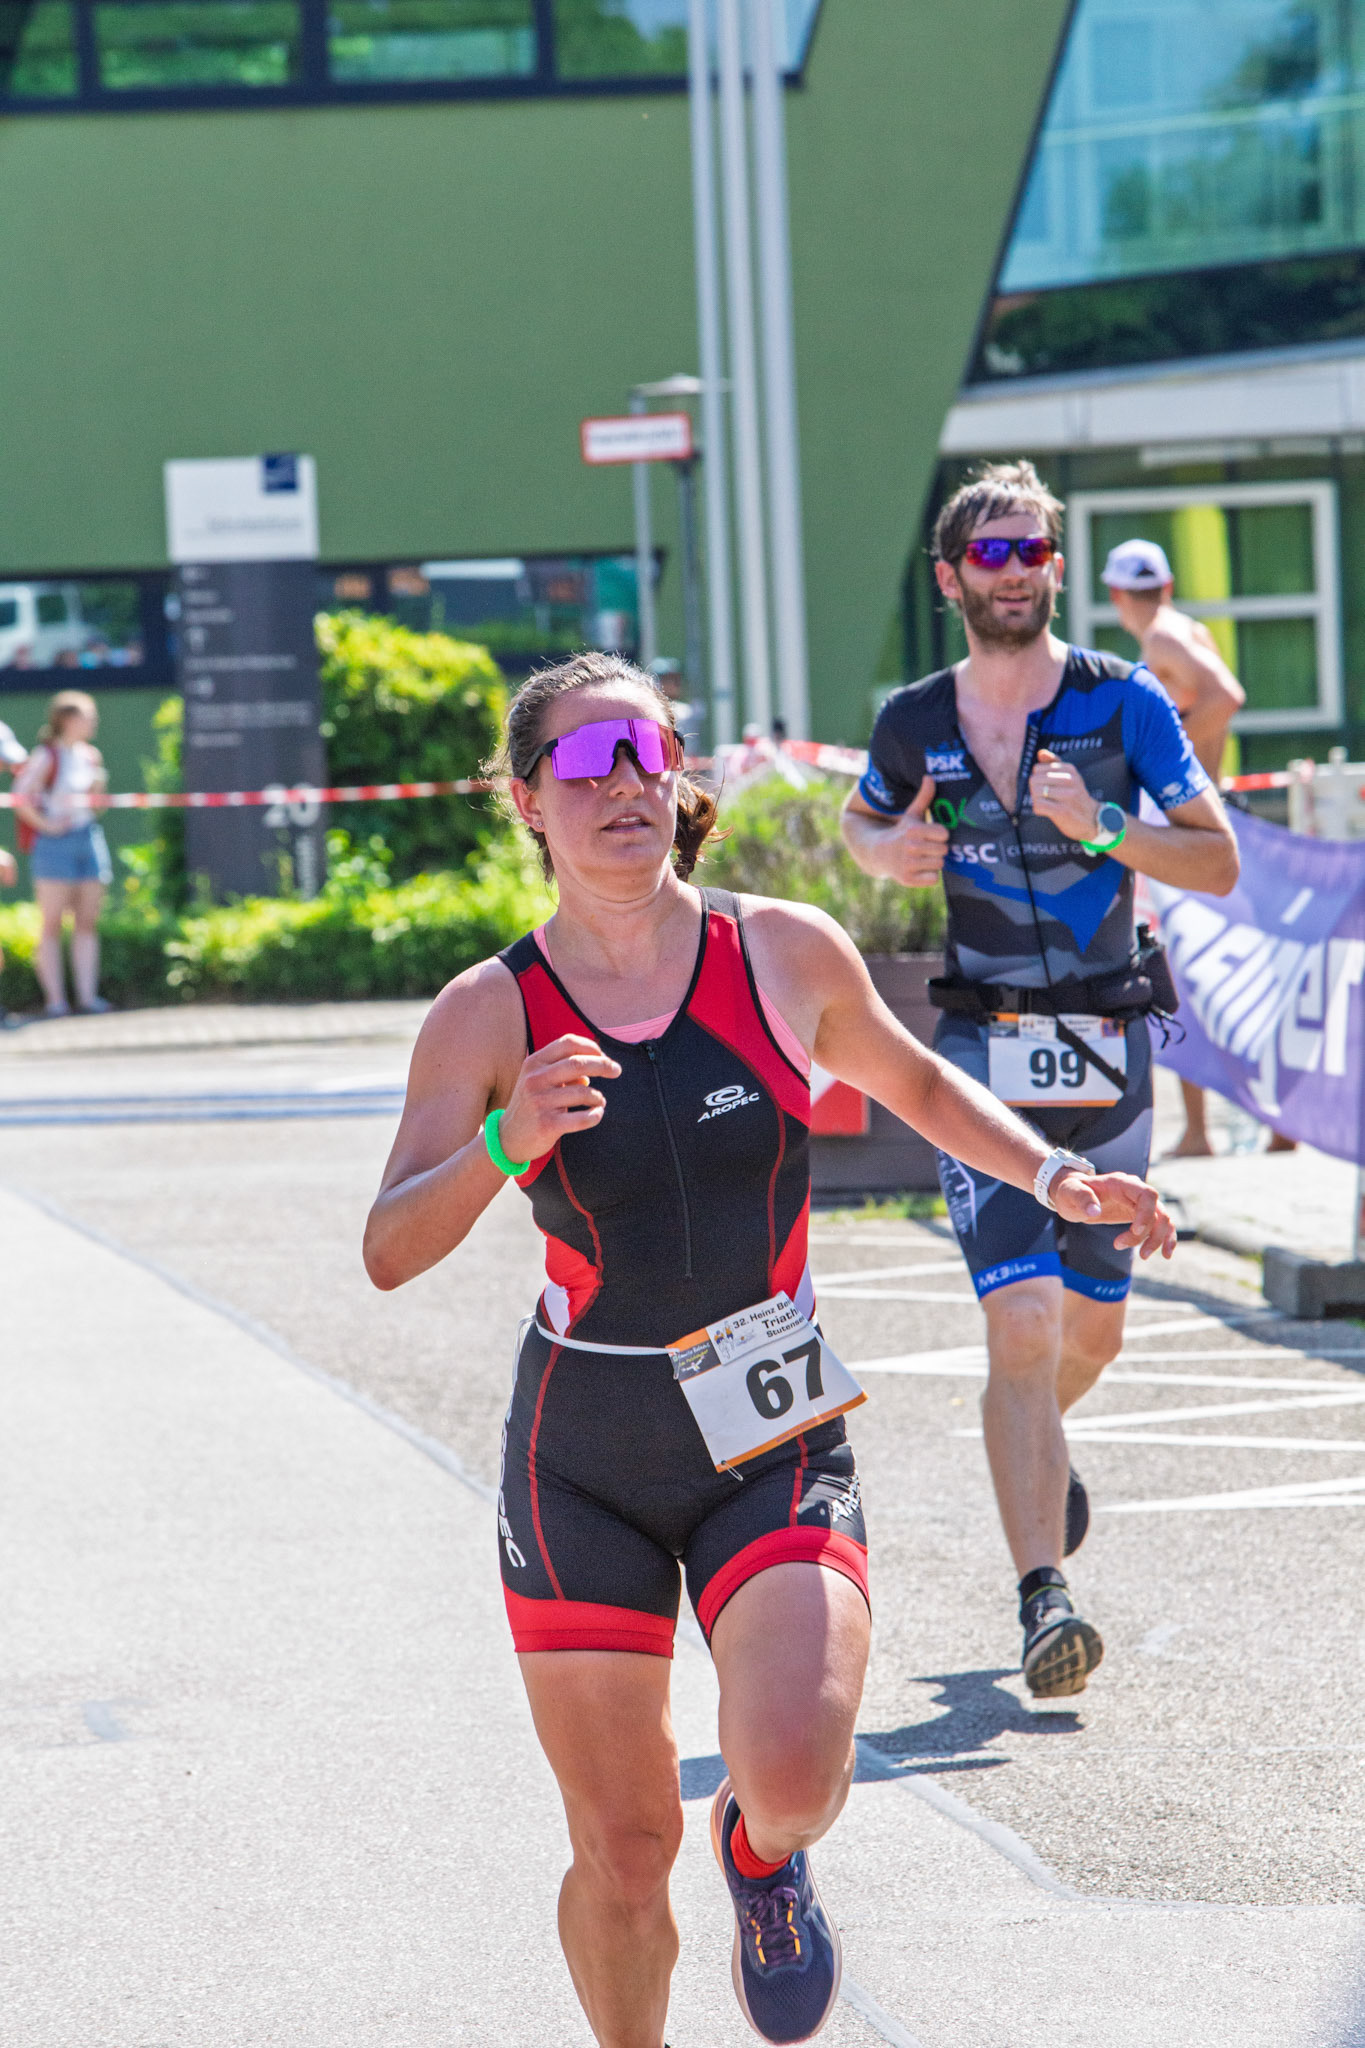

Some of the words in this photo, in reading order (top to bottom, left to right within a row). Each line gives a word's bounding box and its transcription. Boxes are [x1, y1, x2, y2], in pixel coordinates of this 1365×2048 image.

[925, 752, 966, 773] PSK
[951, 843, 999, 864] SSC
[1029, 1048, 1087, 1089] 99
[697, 1092, 760, 1123] AROPEC
[732, 1319, 750, 1330] 32.
[749, 1306, 775, 1322] Heinz
[745, 1336, 825, 1420] 67
